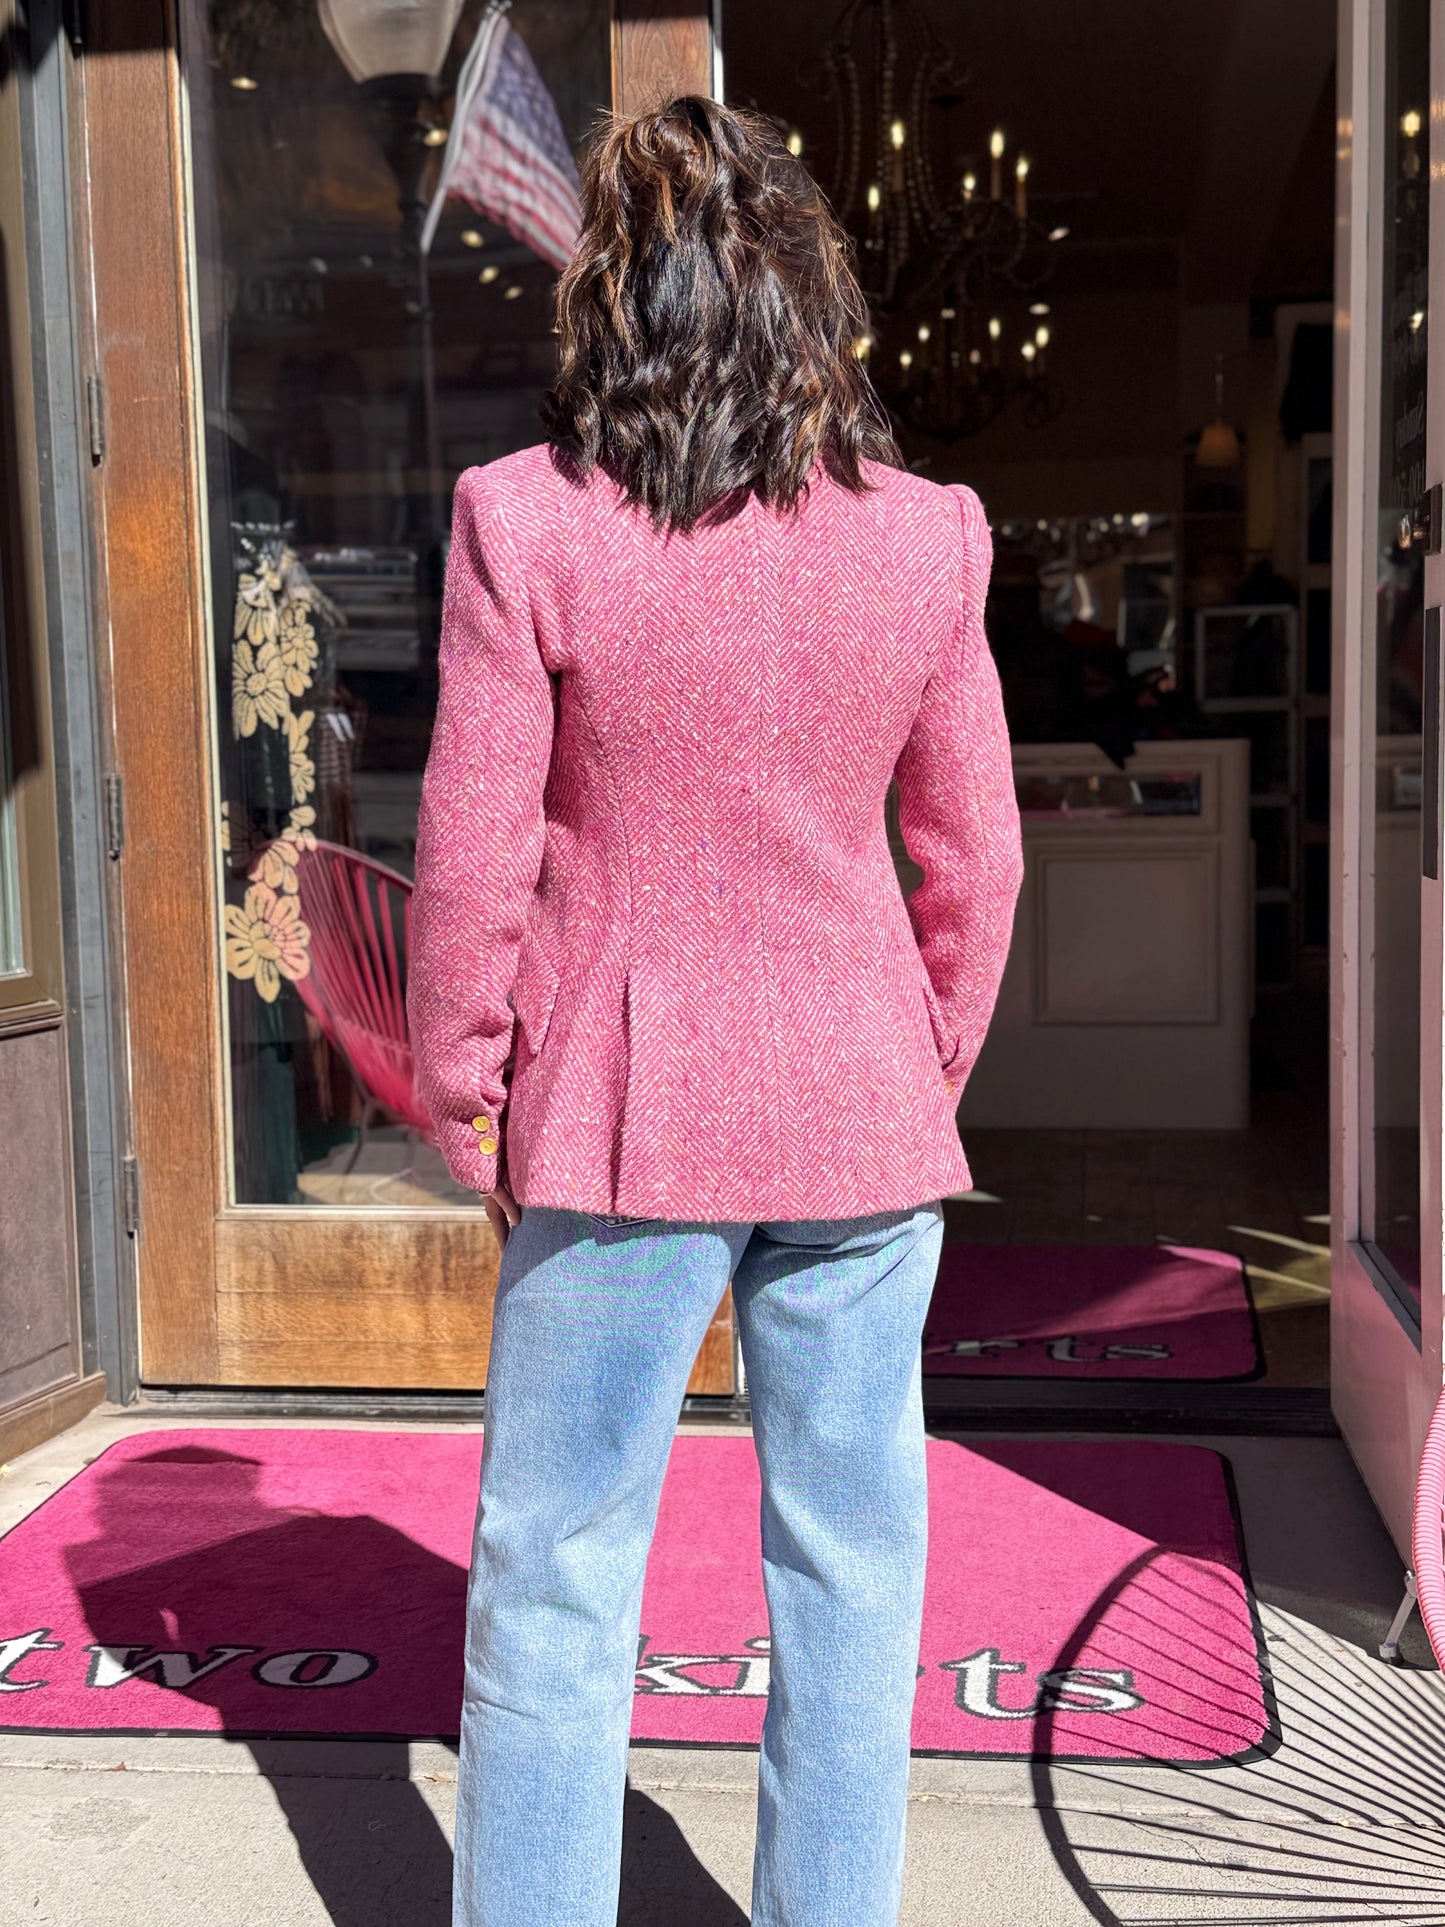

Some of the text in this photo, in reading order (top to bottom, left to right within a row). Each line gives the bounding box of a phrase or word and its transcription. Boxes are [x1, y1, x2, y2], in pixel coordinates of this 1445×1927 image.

[936, 1335, 1175, 1364] rts
[0, 1627, 1146, 1721] two kits
